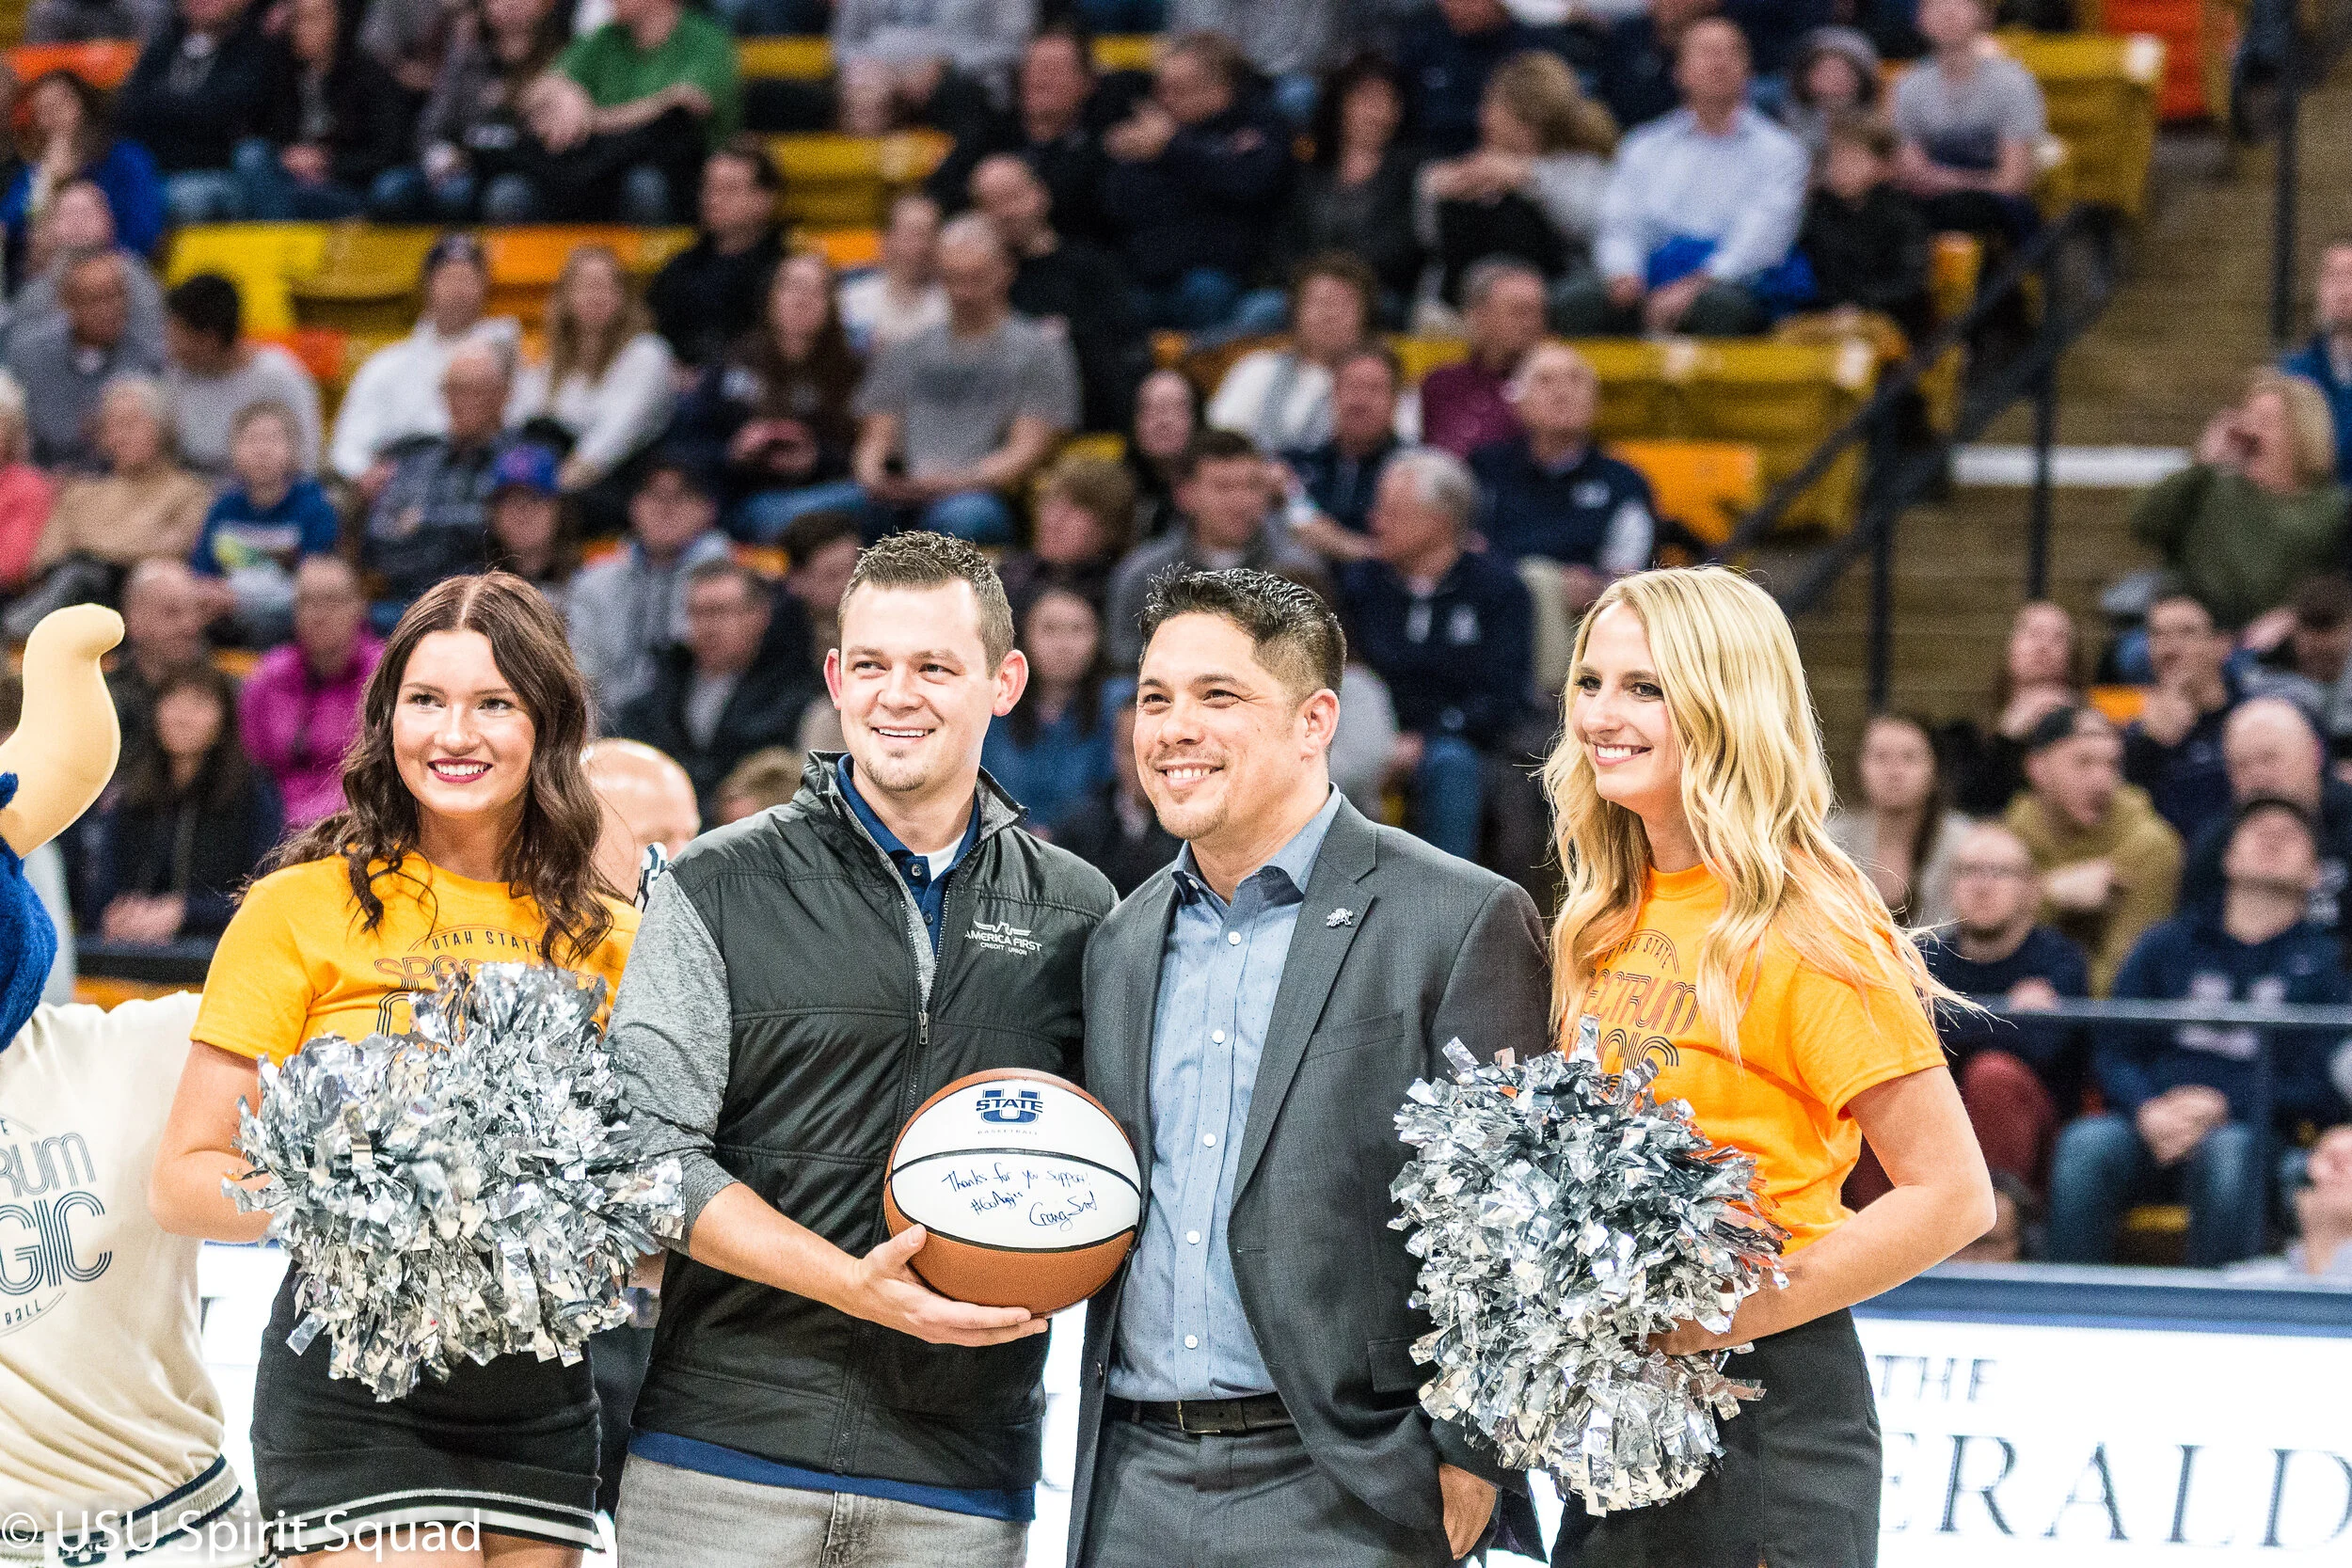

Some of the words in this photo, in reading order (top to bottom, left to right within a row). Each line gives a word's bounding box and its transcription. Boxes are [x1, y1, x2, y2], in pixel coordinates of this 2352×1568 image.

[432, 930, 473, 950] UTAH
[964, 929, 1012, 945] AMERICA
[1013, 938, 1042, 952] FIRST
[980, 942, 1005, 950] CREDIT
[1008, 946, 1027, 956] UNION
[1605, 938, 1641, 962] UTAH
[1643, 937, 1673, 970] STATE
[1583, 968, 1700, 1036] ECTRUM
[976, 1099, 1043, 1114] STATE
[942, 1170, 987, 1192] Thanks
[993, 1162, 1011, 1183] for
[1874, 1354, 1998, 1403] THE
[1881, 1432, 2352, 1550] ERALD
